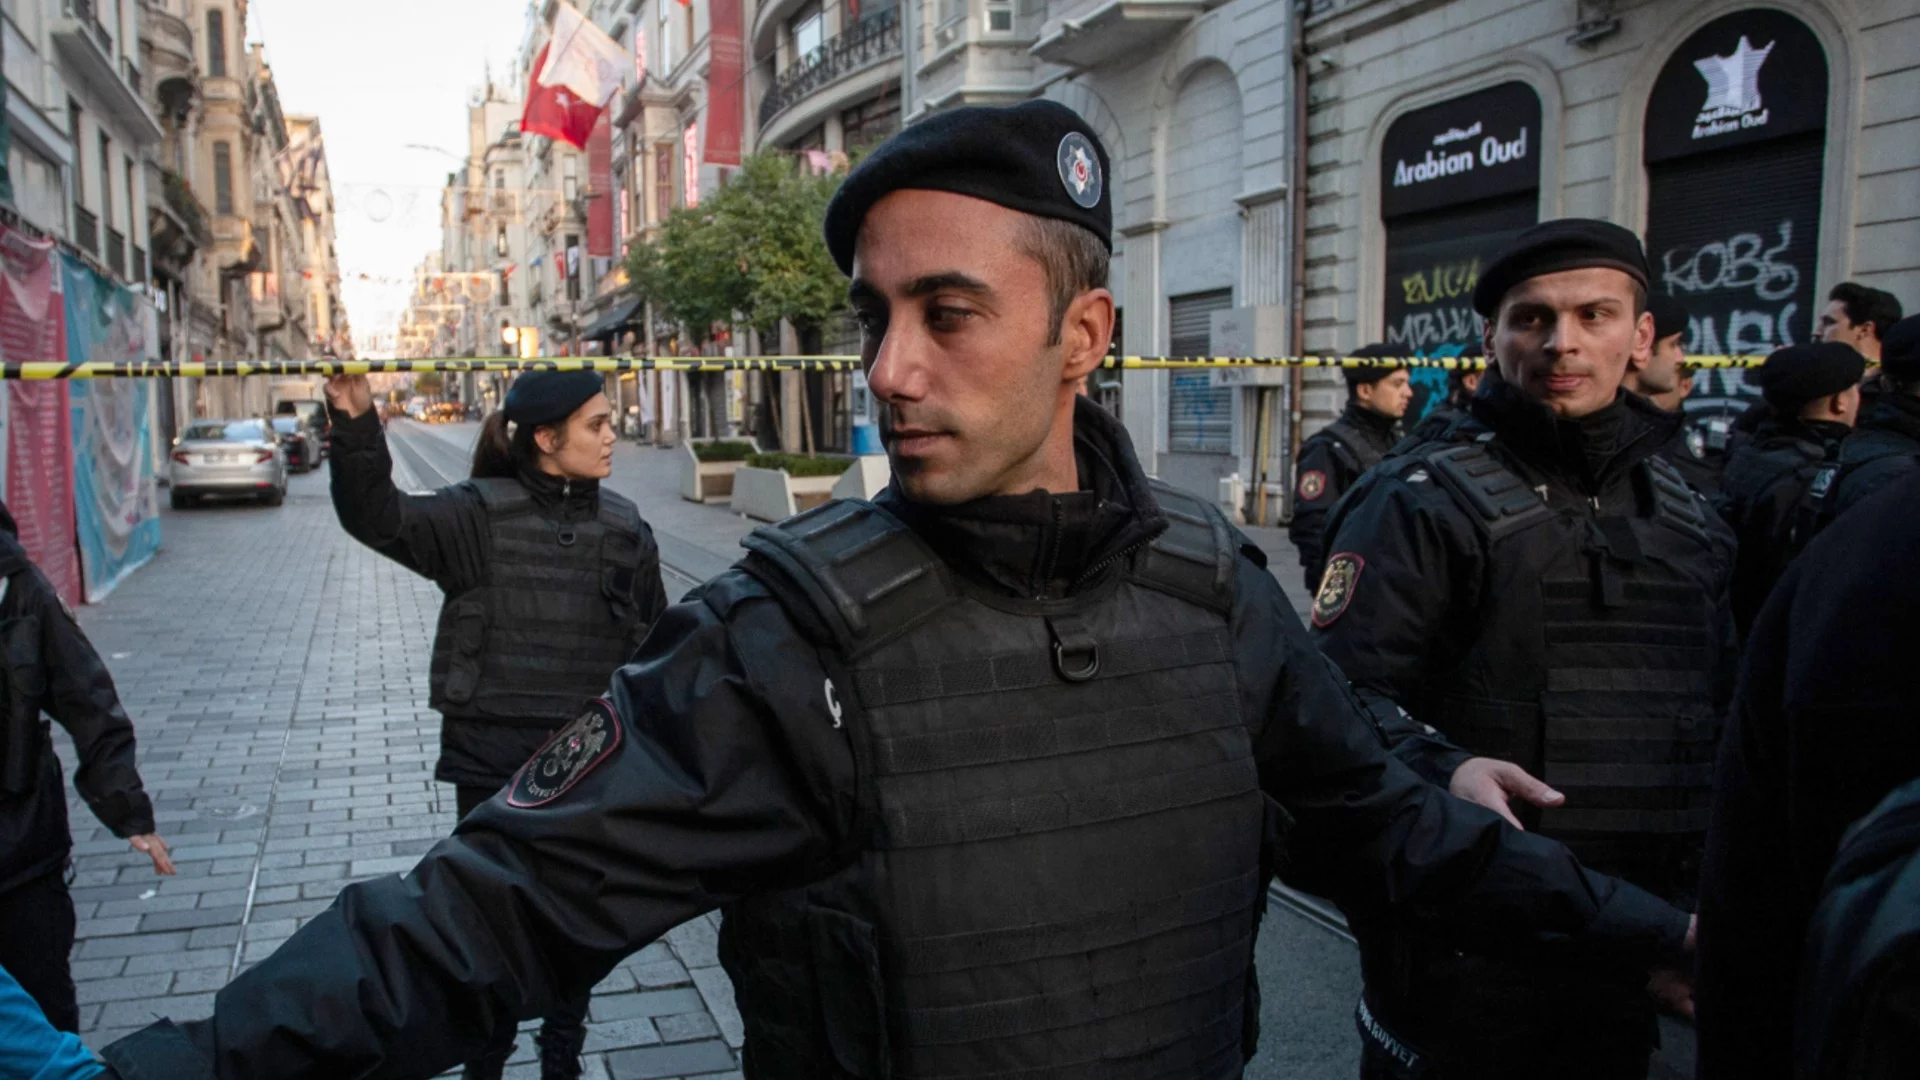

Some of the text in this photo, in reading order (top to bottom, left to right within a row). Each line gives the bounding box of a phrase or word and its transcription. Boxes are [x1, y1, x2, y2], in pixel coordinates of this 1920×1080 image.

[1692, 119, 1739, 139] Arabian
[1741, 108, 1769, 128] Oud
[1393, 150, 1474, 187] Arabian
[1480, 127, 1527, 166] Oud
